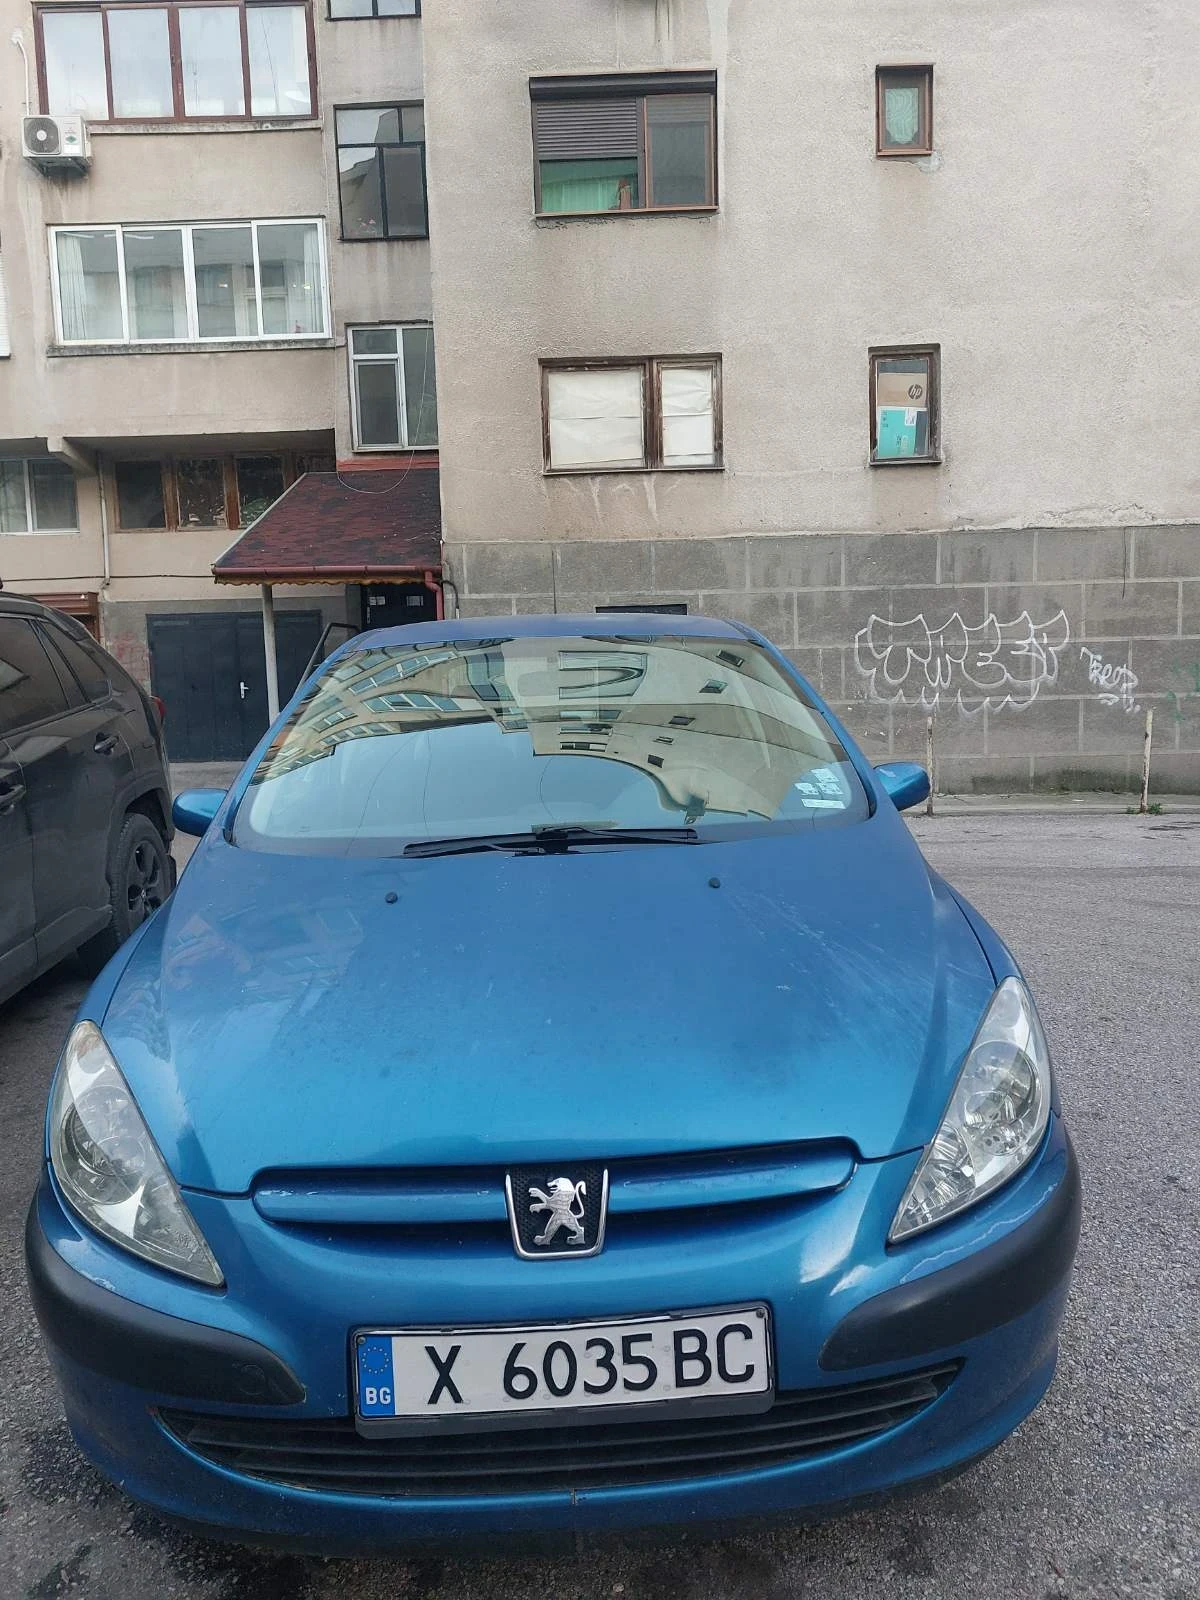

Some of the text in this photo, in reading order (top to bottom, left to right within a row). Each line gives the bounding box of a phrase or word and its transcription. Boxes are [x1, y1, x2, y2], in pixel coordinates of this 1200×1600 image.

[908, 384, 923, 400] hp
[424, 1345, 464, 1405] X
[503, 1333, 658, 1400] 6035
[365, 1386, 392, 1406] BG
